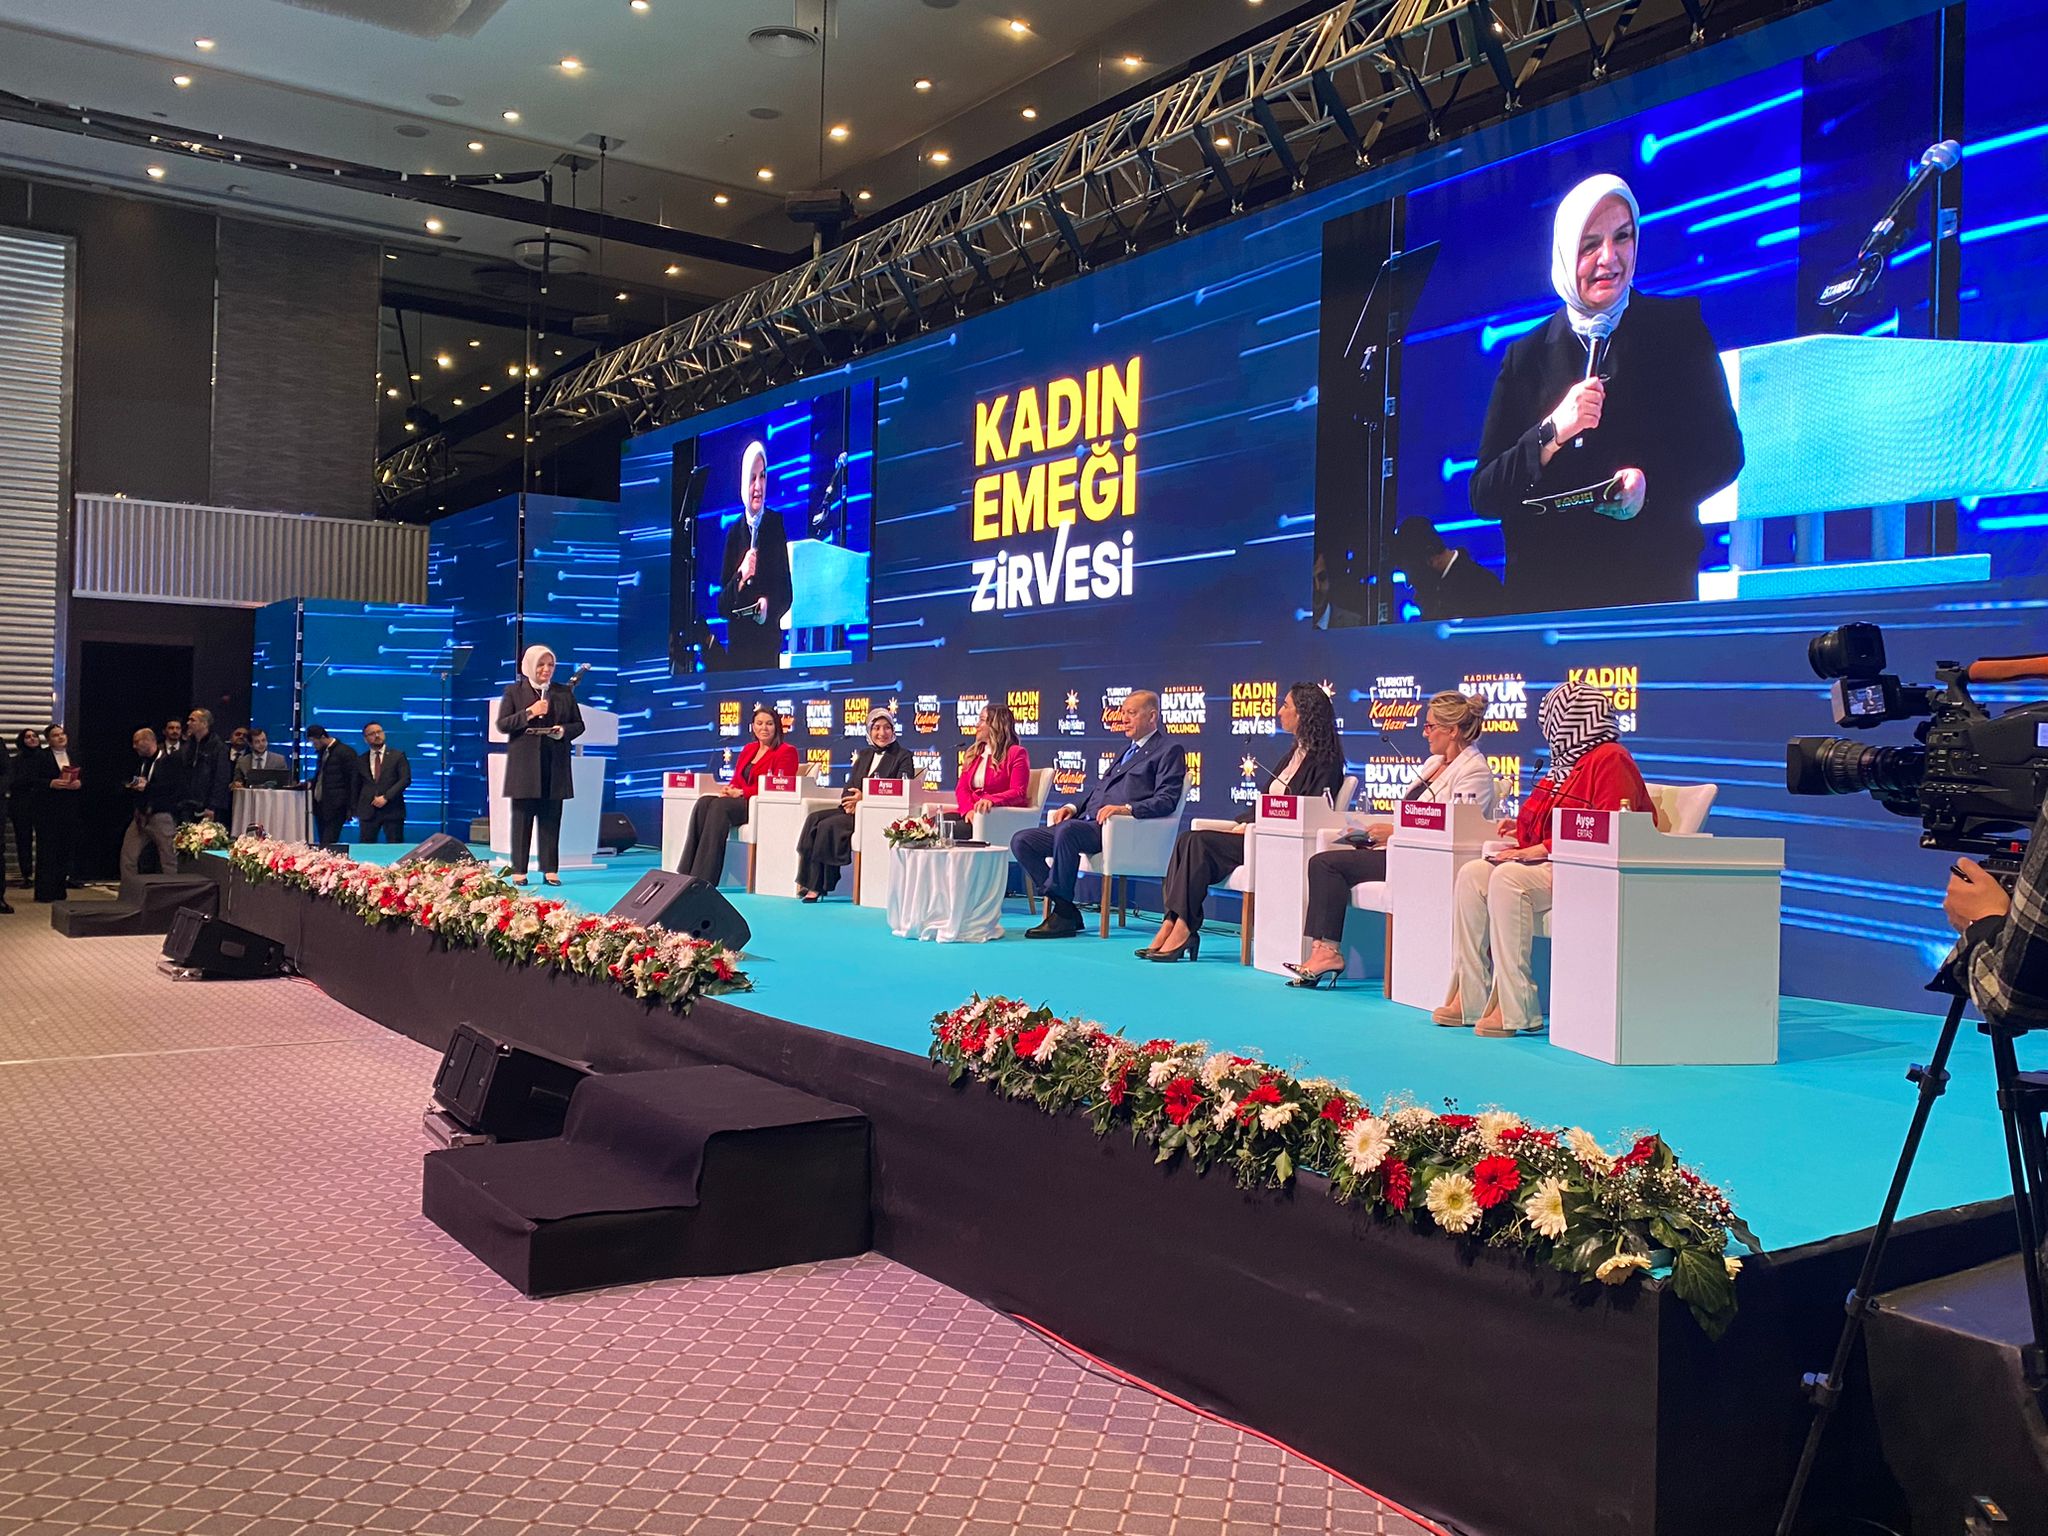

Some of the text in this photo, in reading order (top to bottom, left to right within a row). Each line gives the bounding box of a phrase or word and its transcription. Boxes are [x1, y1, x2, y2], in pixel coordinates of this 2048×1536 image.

[974, 356, 1140, 467] KADIN
[973, 432, 1137, 542] EMEĞİ
[1568, 666, 1637, 688] KADIN
[1007, 691, 1039, 706] KADIN
[1231, 682, 1277, 700] KADIN
[720, 702, 739, 713] KADIN
[844, 698, 868, 711] KADIN
[1231, 701, 1277, 718] EMEĞİ
[1369, 699, 1423, 719] Kadınlar
[1014, 718, 1039, 735] RVESİ
[1166, 723, 1200, 734] YOLUNDA
[1382, 718, 1407, 731] Hazır
[1481, 720, 1519, 732] LUNDA
[1487, 756, 1520, 775] DIN
[772, 777, 788, 785] Emine
[1270, 797, 1289, 809] Merve
[1404, 803, 1442, 817] Sühendam
[1575, 813, 1595, 829] Ayşe
